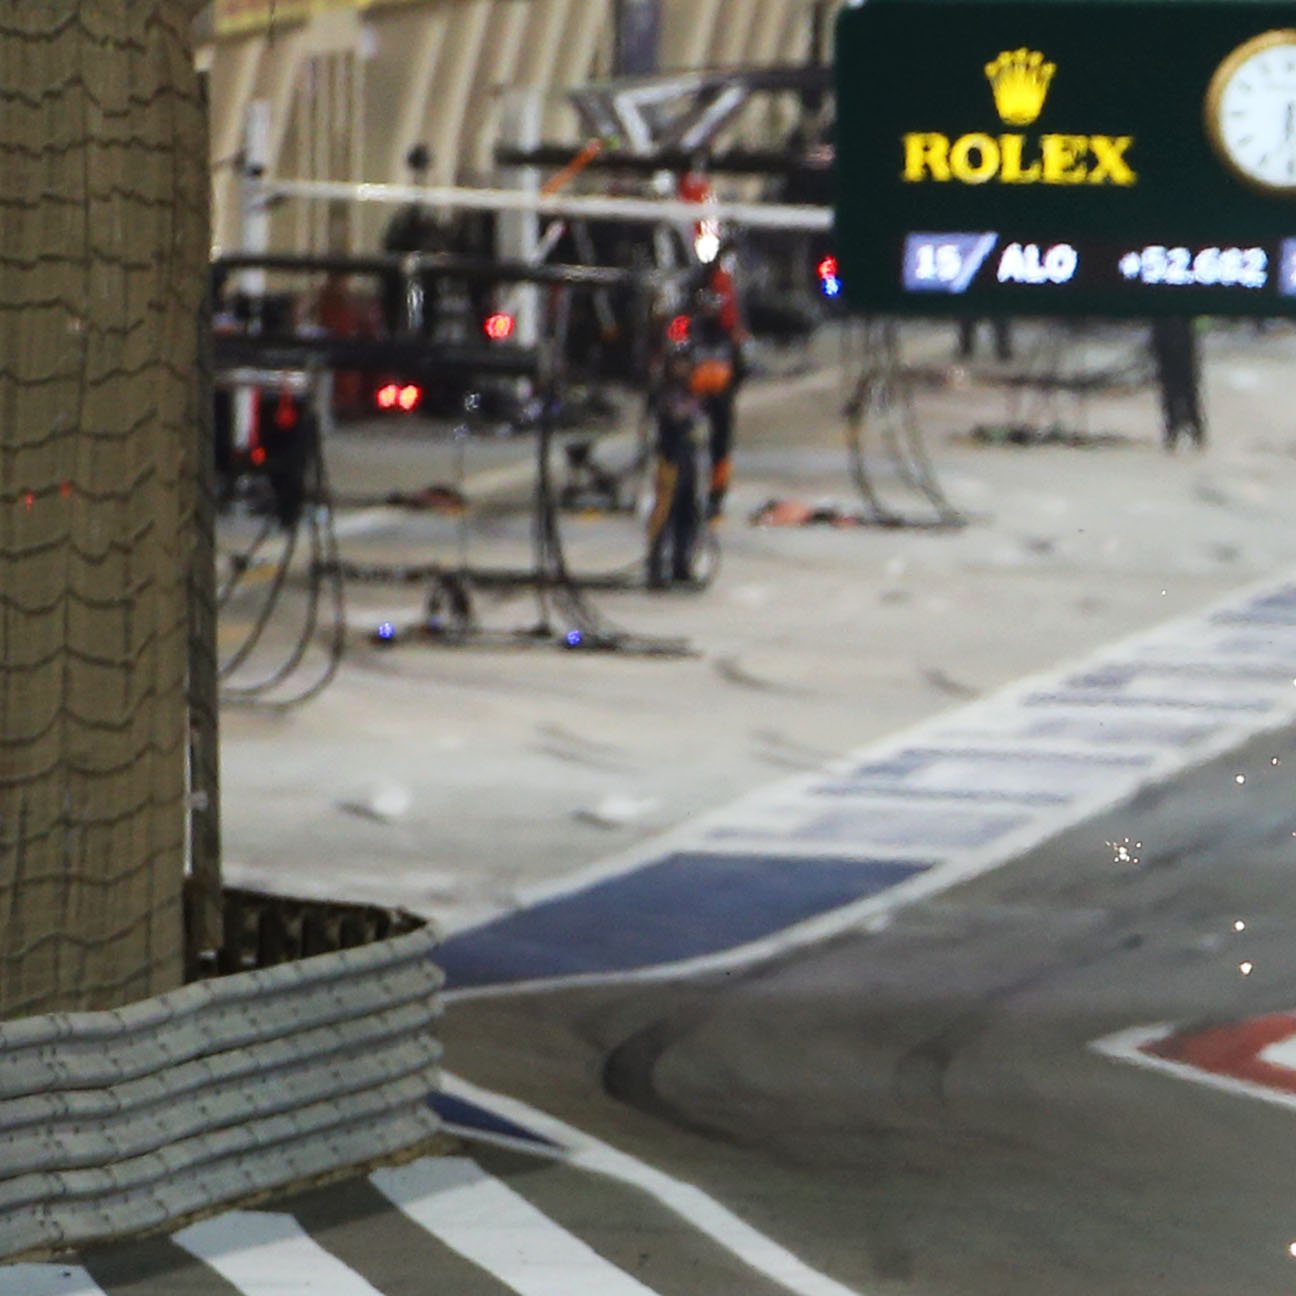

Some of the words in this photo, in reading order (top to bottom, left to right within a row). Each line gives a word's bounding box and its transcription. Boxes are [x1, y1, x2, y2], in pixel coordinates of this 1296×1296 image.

[902, 132, 1137, 186] ROLEX
[915, 243, 963, 283] 15
[996, 242, 1078, 285] ALO
